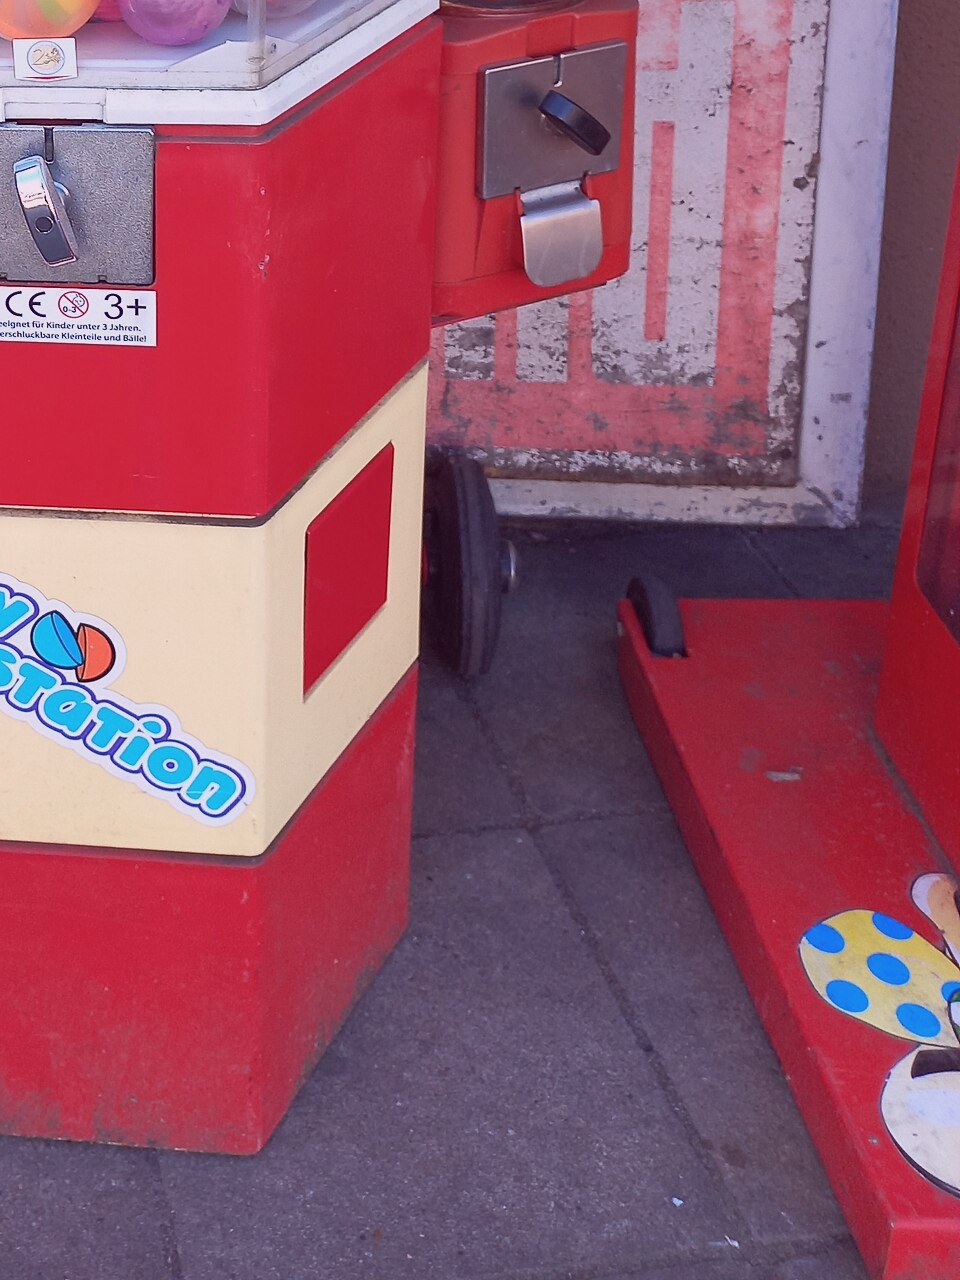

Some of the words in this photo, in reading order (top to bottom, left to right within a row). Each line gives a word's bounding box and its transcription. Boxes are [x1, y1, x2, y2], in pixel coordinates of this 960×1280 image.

[103, 293, 147, 320] 3+
[32, 320, 45, 328] für
[46, 322, 75, 330] Kinder
[77, 323, 101, 331] unter
[102, 323, 108, 331] 3
[109, 323, 142, 332] Jahren.
[61, 332, 102, 341] Kleinteile
[103, 334, 121, 342] und
[123, 334, 147, 343] Bälle!
